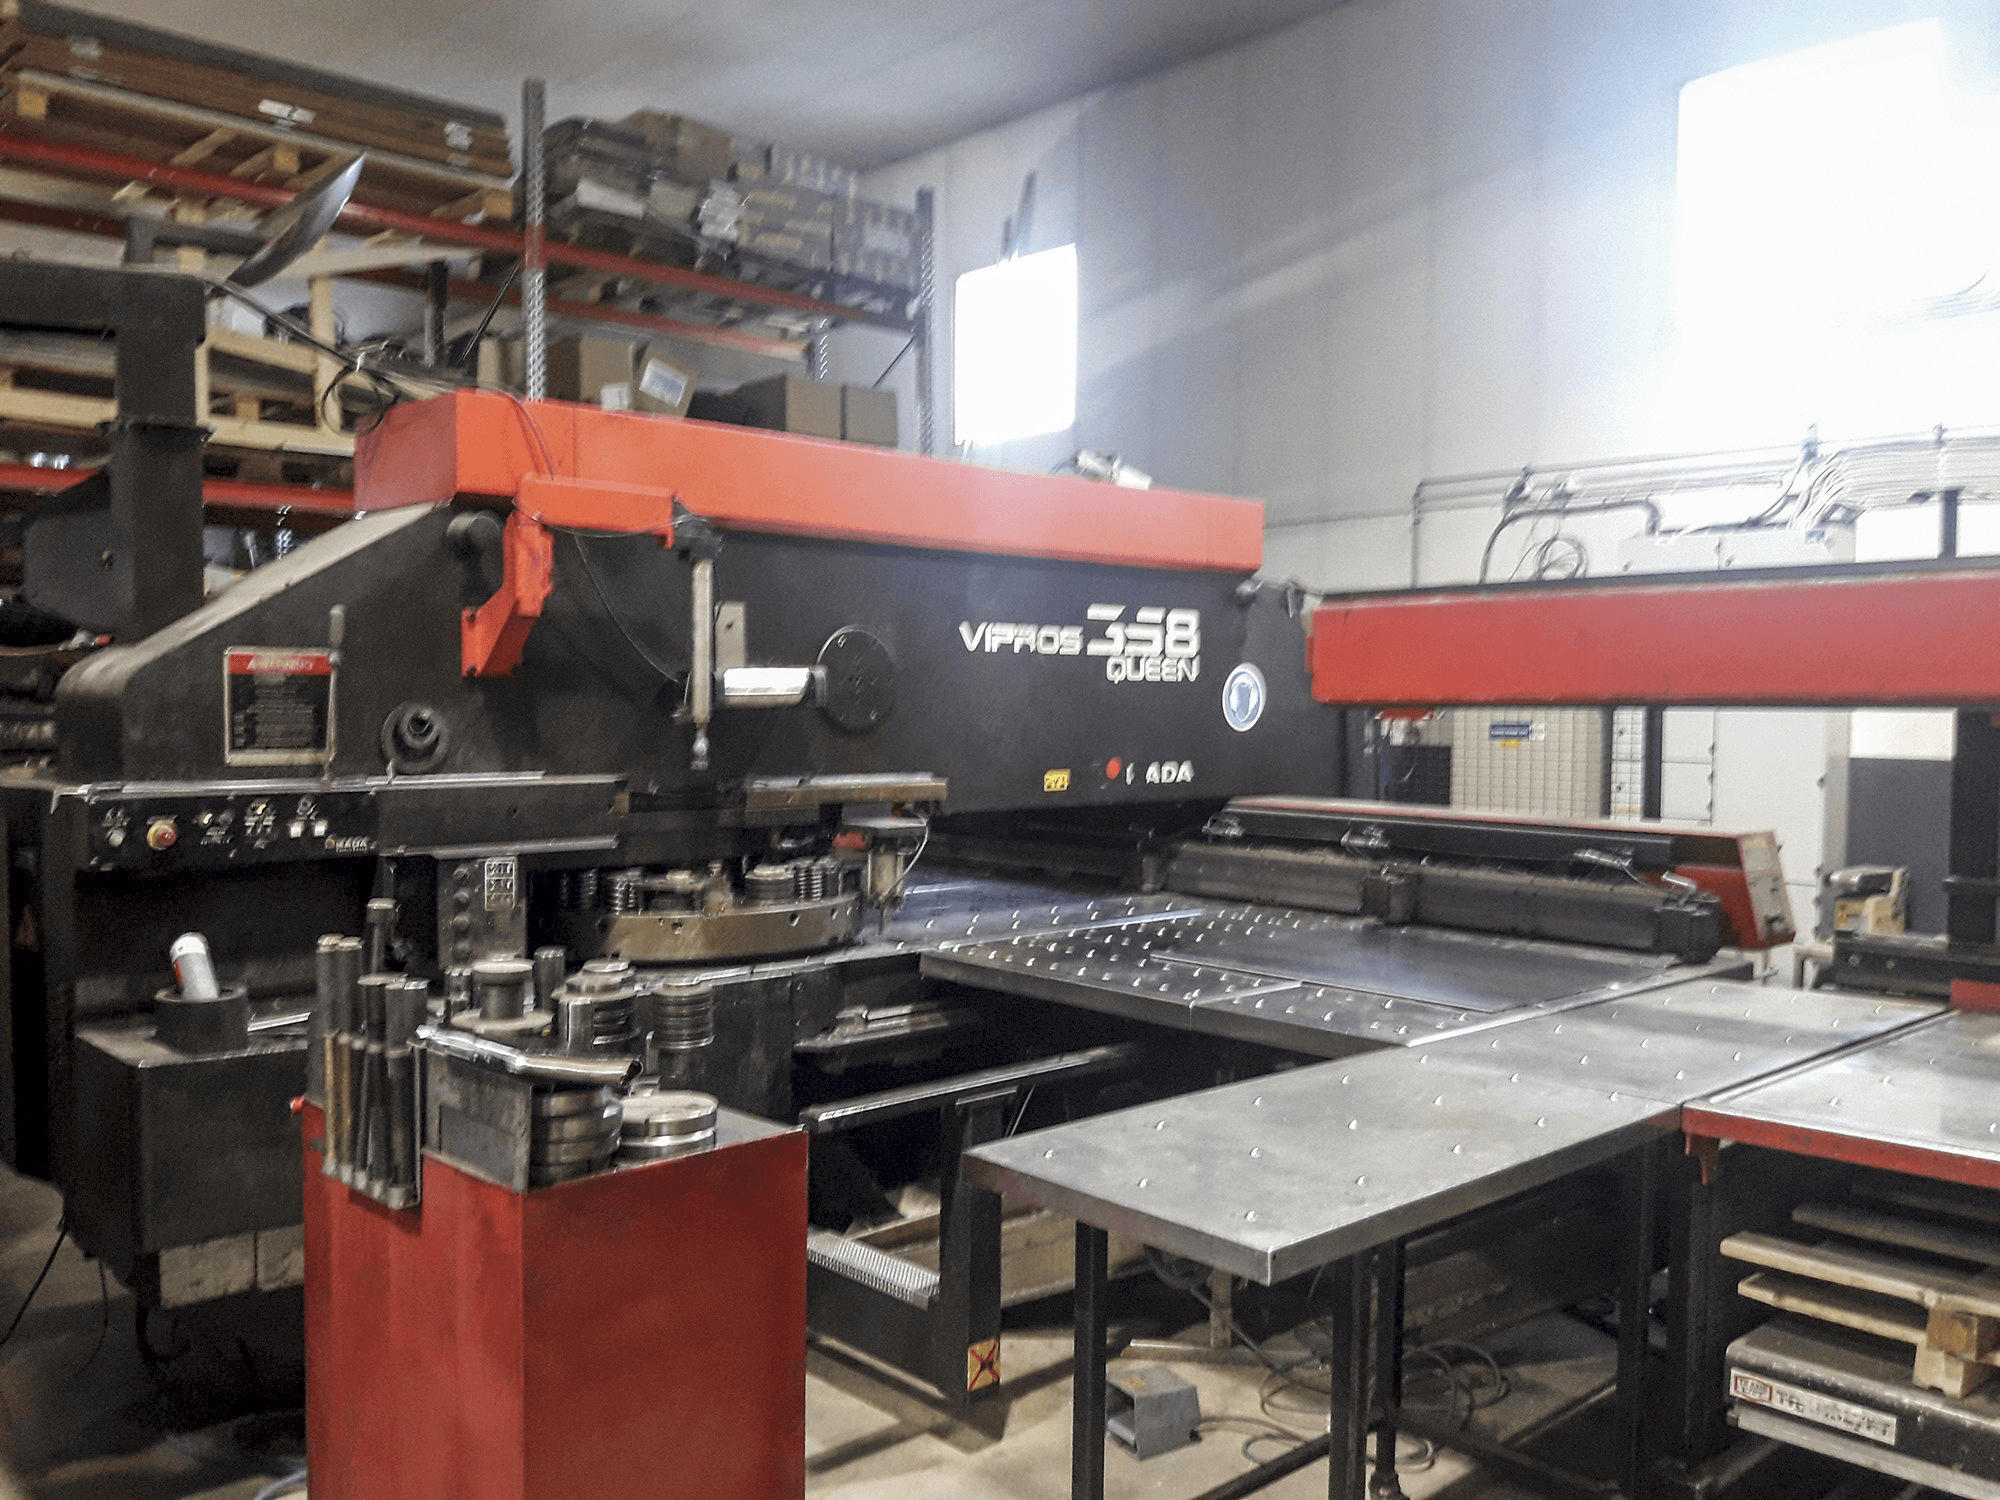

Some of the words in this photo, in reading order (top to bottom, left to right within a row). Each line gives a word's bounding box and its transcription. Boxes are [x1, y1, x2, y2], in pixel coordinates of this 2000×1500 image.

[959, 621, 1084, 655] VIPROS
[1087, 603, 1201, 657] 358
[1106, 655, 1201, 684] QUEEN
